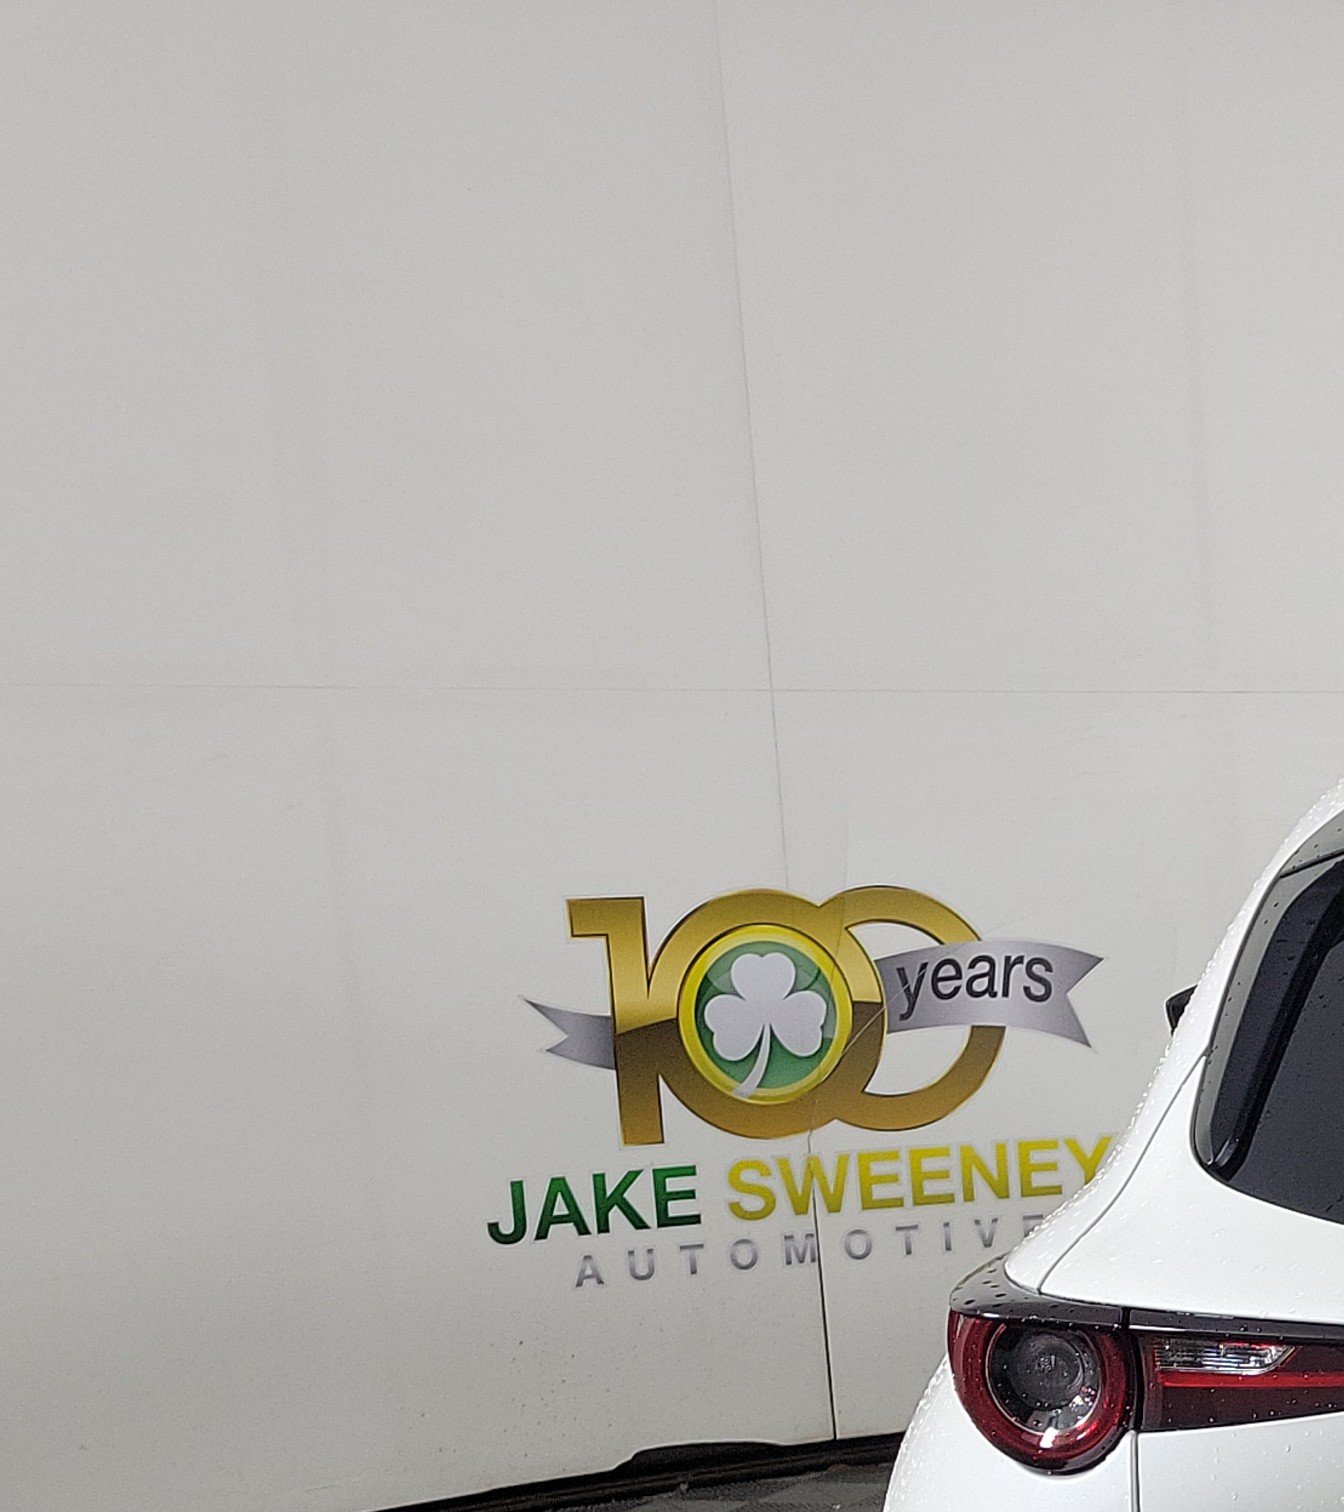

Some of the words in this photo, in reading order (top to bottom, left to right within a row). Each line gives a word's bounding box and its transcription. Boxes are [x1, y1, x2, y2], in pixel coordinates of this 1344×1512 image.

[566, 885, 1006, 1146] 100
[896, 954, 1053, 1020] years
[487, 1164, 702, 1245] JAKE
[727, 1135, 1112, 1222] SWEENEY
